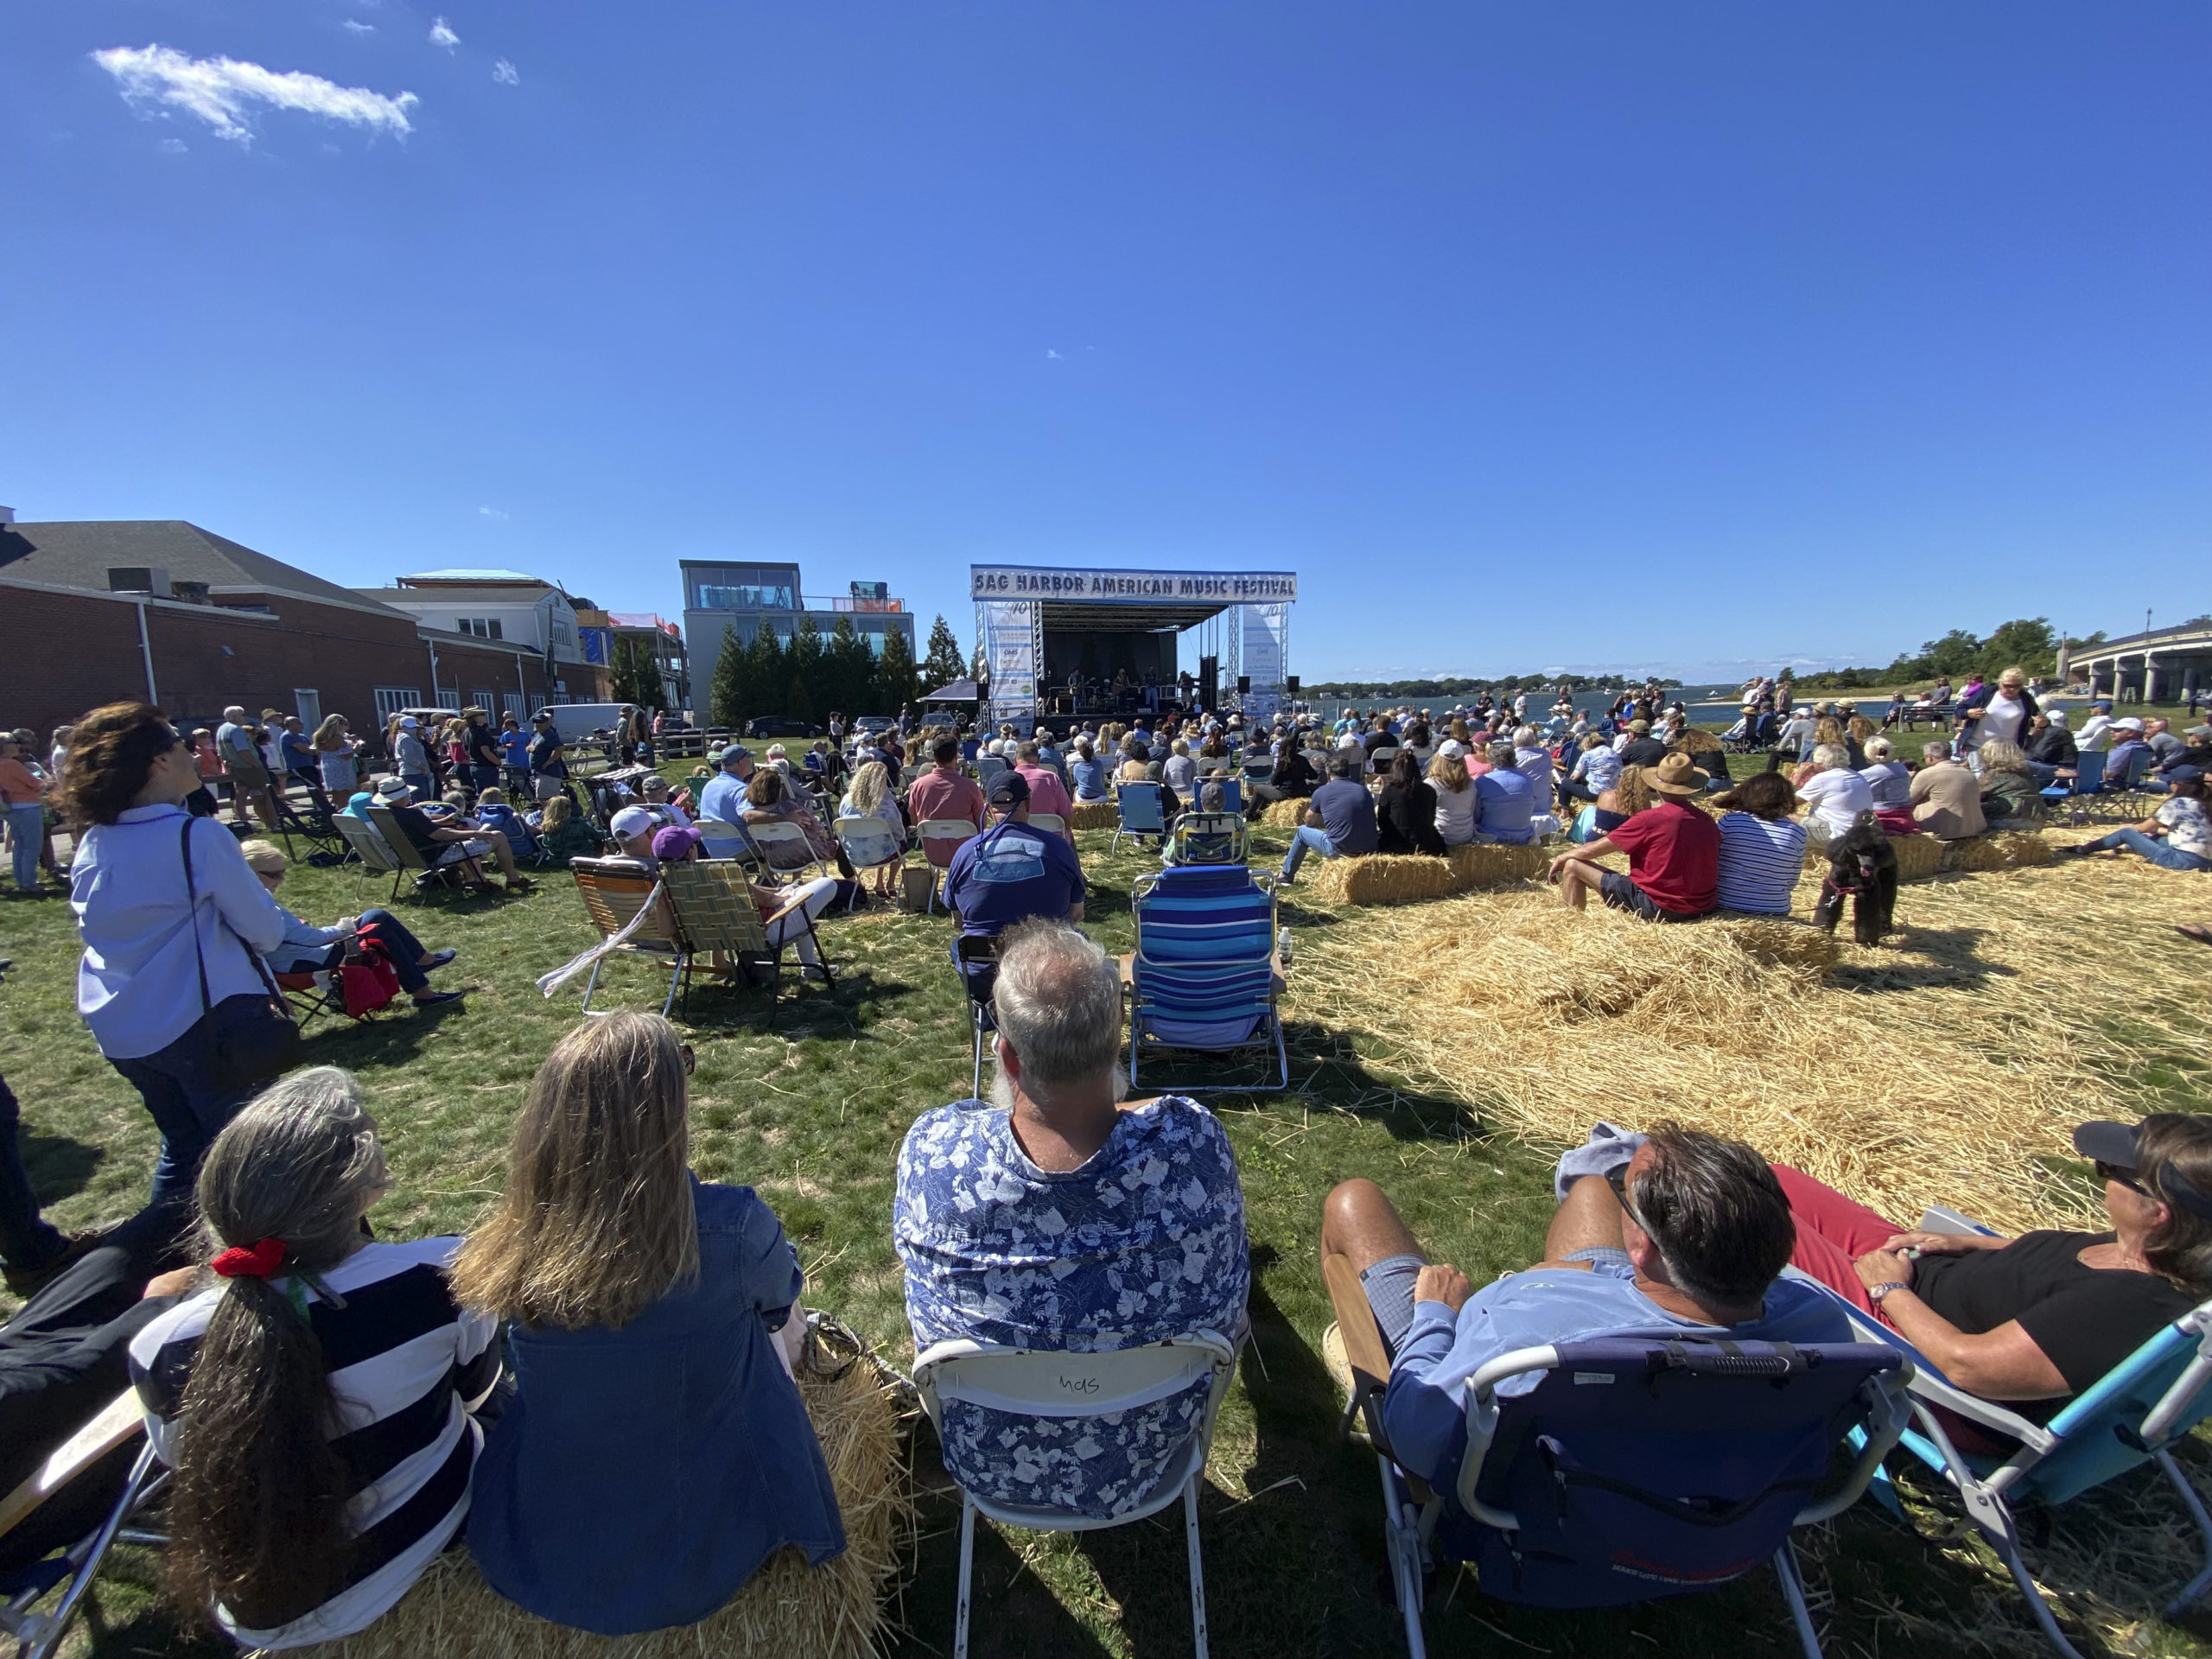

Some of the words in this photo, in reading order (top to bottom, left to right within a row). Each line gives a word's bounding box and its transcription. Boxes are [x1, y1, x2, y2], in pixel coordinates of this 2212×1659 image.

[975, 575, 1009, 591] SAG
[1016, 575, 1084, 593] HARBOR
[1091, 577, 1173, 594] AMERICAN
[1180, 579, 1228, 594] MUSIC
[1234, 580, 1294, 596] FESTIVAL
